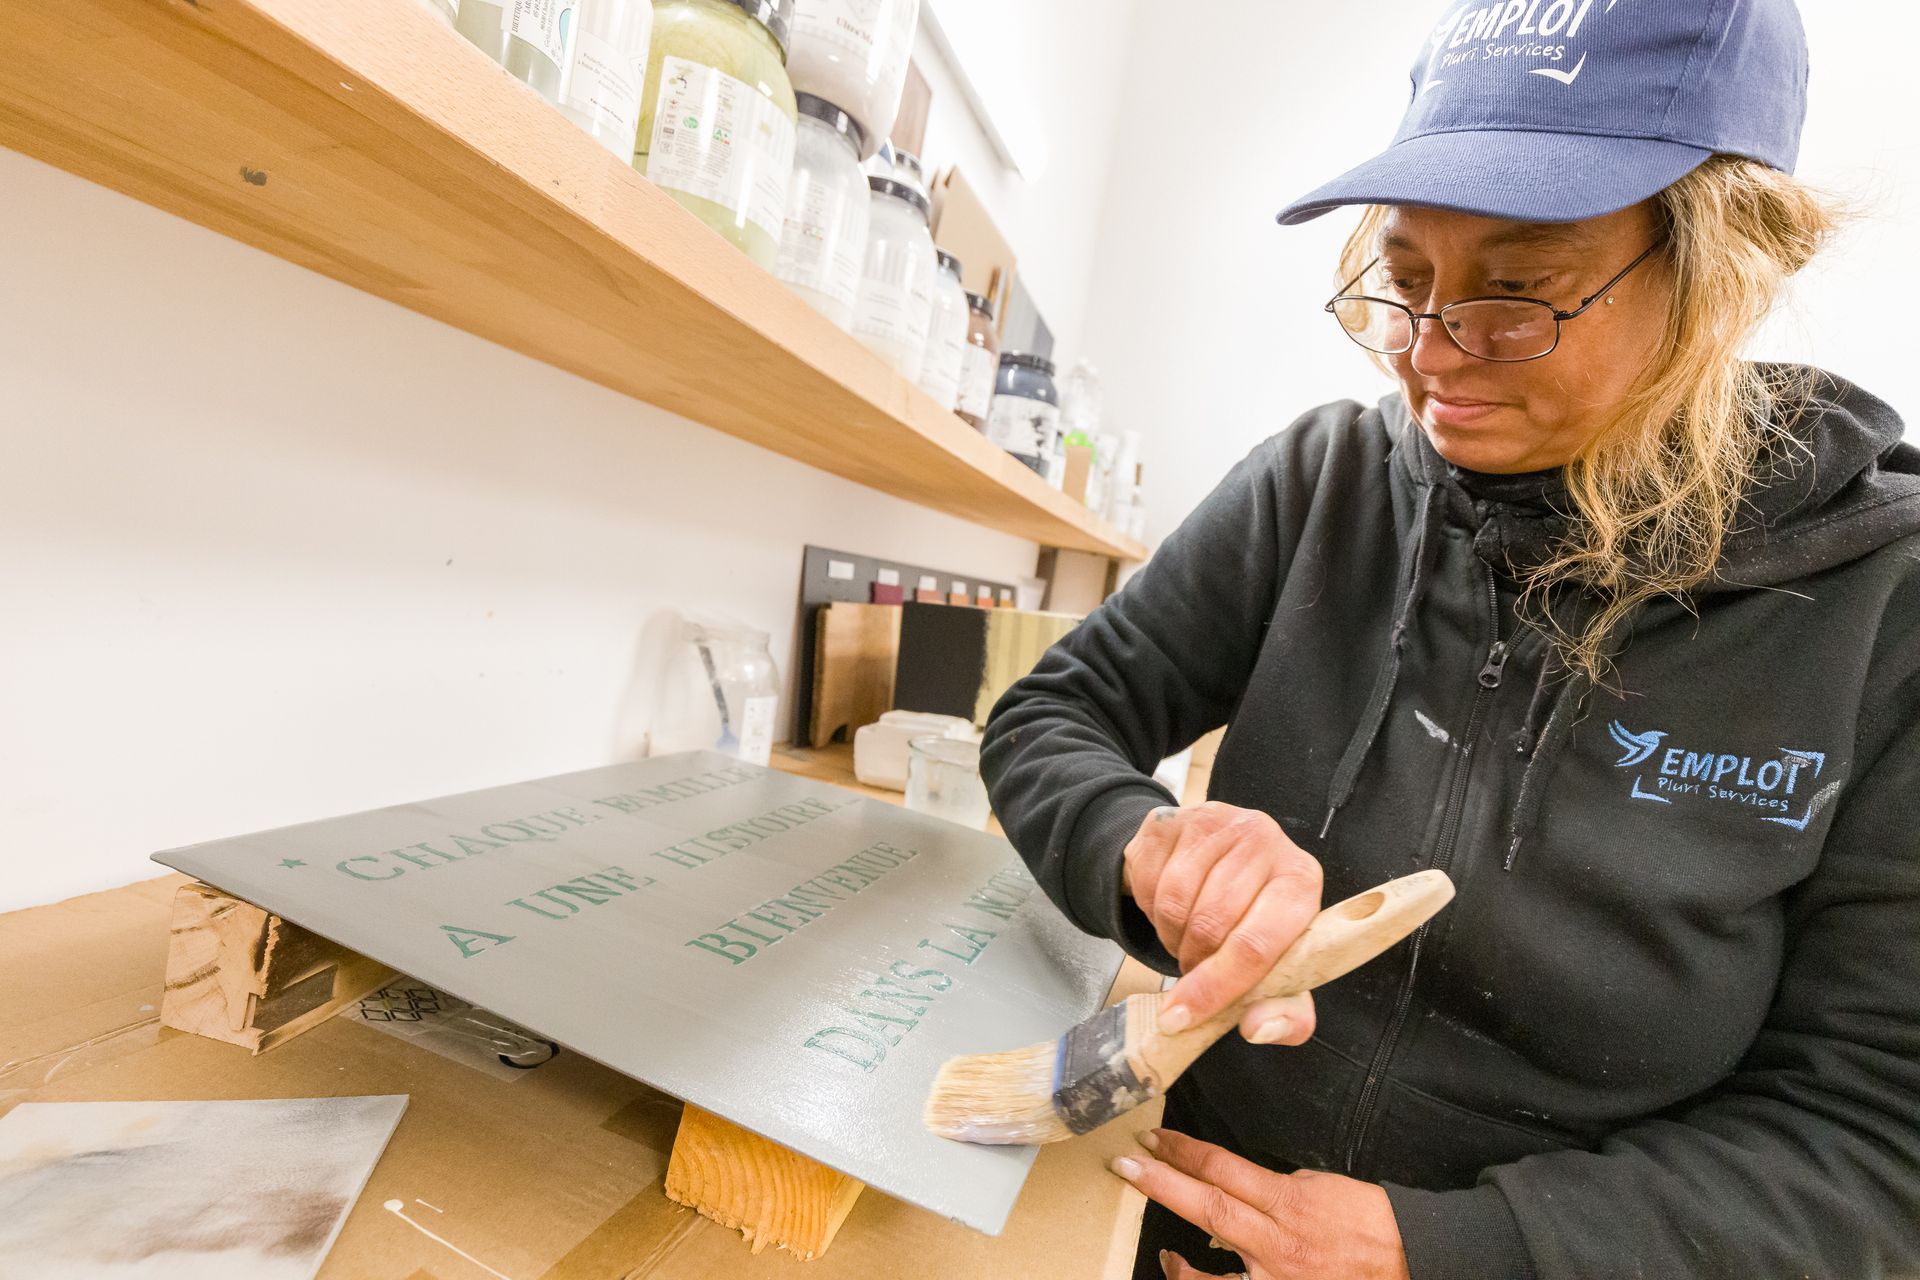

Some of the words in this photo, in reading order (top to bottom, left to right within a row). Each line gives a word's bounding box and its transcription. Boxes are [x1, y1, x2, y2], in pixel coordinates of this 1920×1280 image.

[1440, 47, 1478, 70] Pluri
[1482, 42, 1565, 61] Services
[335, 807, 604, 881] CHAQUE
[592, 767, 762, 814] FAMILLE
[1657, 777, 1700, 795] Pluri
[1708, 785, 1790, 812] Services
[439, 924, 517, 959] A
[504, 866, 657, 920] UNE
[651, 797, 844, 870] HISTOIRE
[684, 841, 922, 965] BIENVENUE
[804, 960, 952, 1073] DANS
[917, 923, 998, 965] LA
